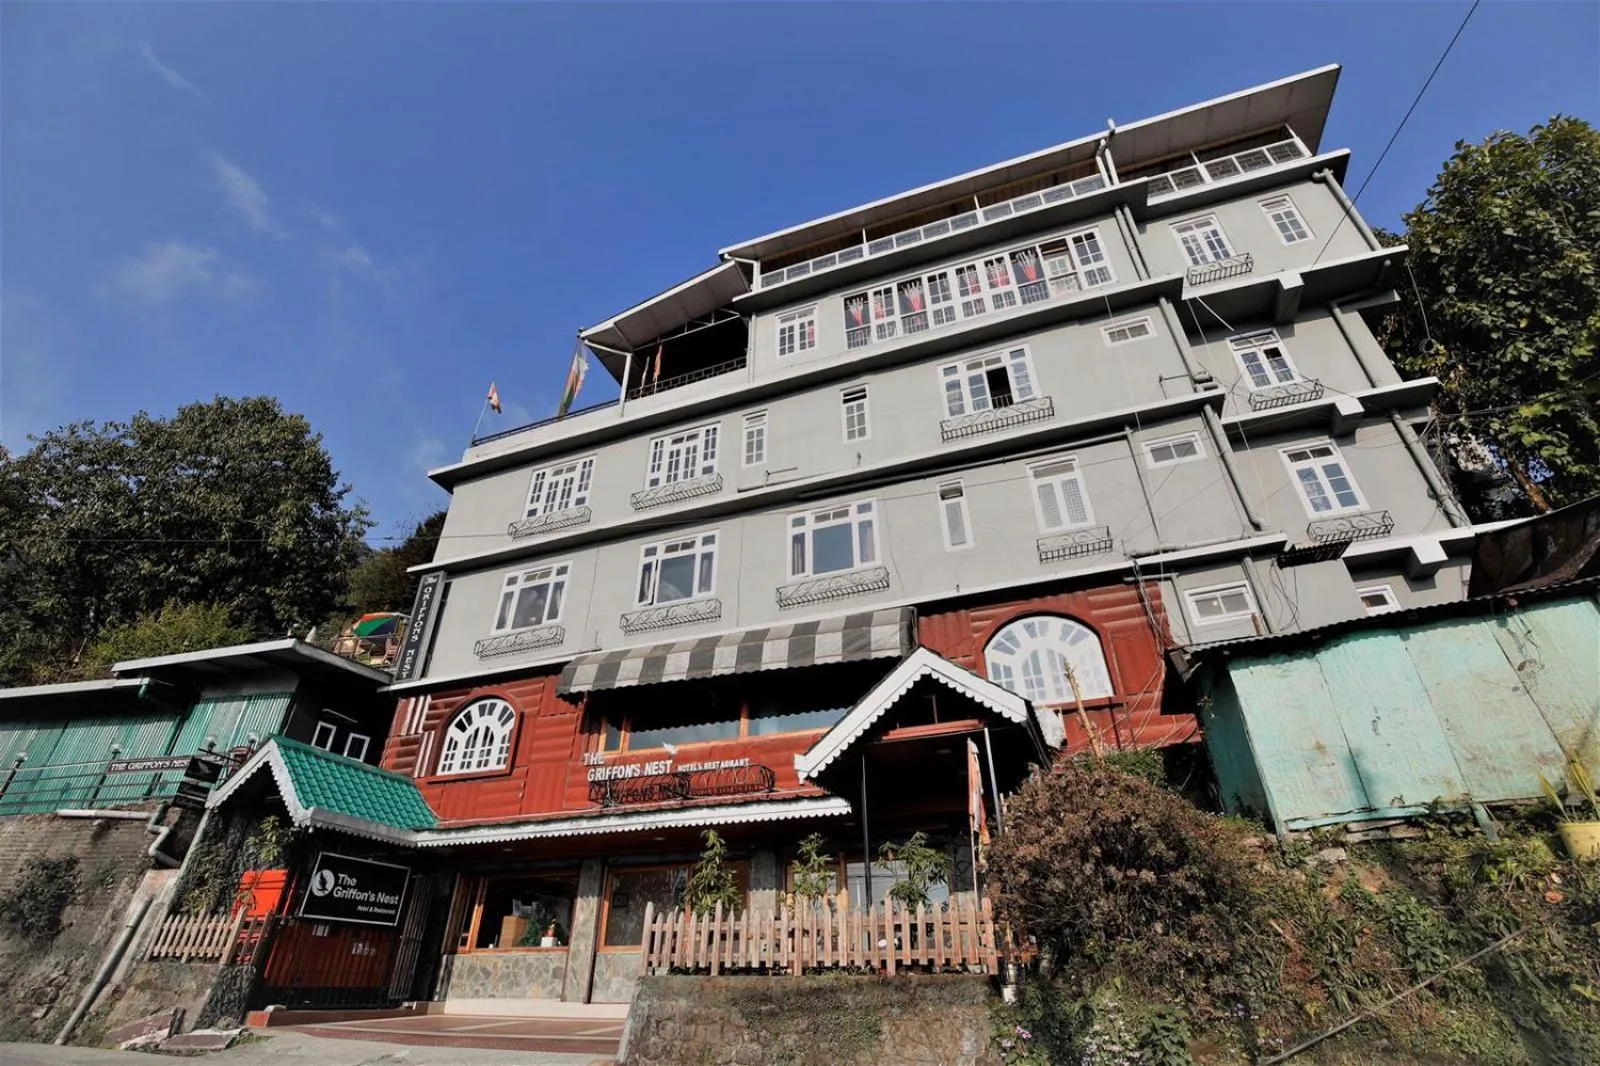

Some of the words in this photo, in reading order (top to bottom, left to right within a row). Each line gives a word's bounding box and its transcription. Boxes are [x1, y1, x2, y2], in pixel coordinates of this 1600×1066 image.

[402, 649, 415, 678] NEST
[584, 752, 604, 766] THE
[588, 763, 641, 782] GRIFFON'S
[644, 760, 673, 776] NEST
[338, 873, 357, 886] The
[333, 886, 376, 902] Griffon's
[377, 892, 399, 904] Nest
